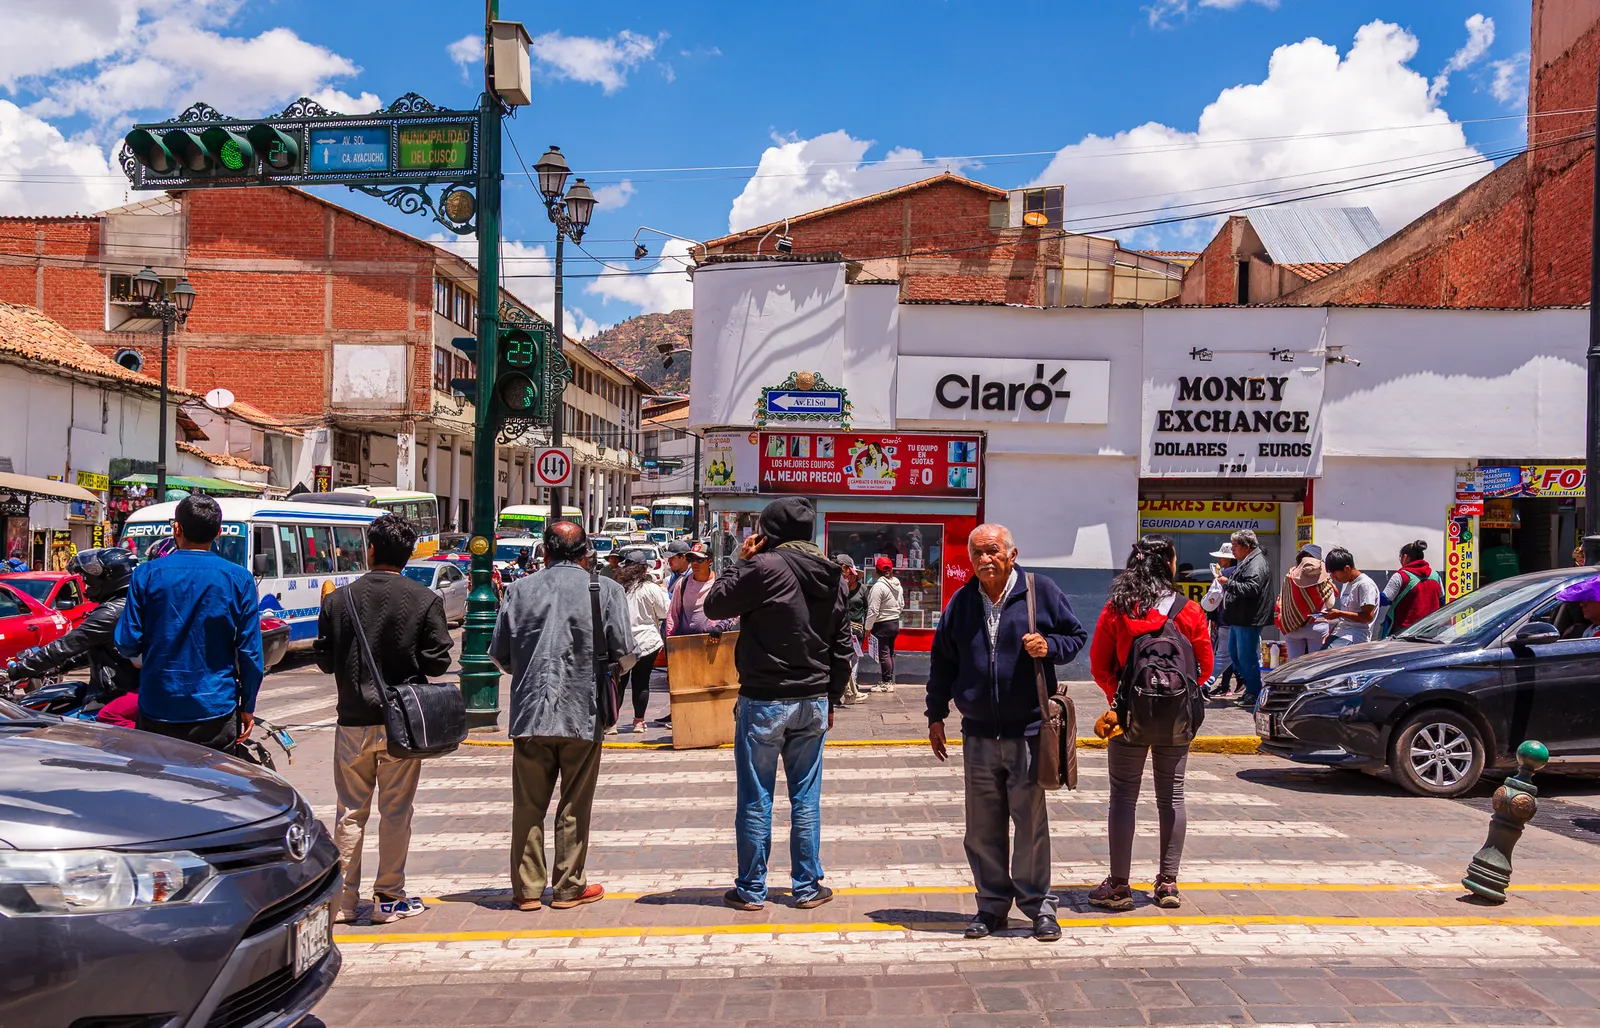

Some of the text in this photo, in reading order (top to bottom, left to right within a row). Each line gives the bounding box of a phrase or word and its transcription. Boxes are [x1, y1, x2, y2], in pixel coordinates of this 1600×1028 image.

[342, 136, 364, 145] AV. SOL
[401, 129, 469, 144] MUNICIPALIDAD
[342, 152, 384, 163] CA. AYACUCHO
[411, 149, 457, 163] DEL CUSCO
[506, 340, 533, 364] 23
[936, 365, 1068, 411] Claro
[1177, 376, 1289, 402] MONEY
[806, 398, 814, 406] El
[815, 398, 826, 407] Sol
[1157, 409, 1310, 433] EXCHANGE
[881, 436, 902, 444] Claro
[908, 444, 938, 452] TU EQUIPO
[1154, 442, 1228, 457] DOLARES
[1258, 442, 1312, 457] EUROS
[771, 459, 835, 469] LOS MEJORES EQUIPOS
[1230, 464, 1248, 473] 290
[764, 470, 842, 483] AL MEJOR PRECIO
[921, 467, 933, 485] 0
[1211, 501, 1276, 513] EUROS
[1197, 518, 1206, 528] Y
[1206, 518, 1259, 529] GARANTÍA
